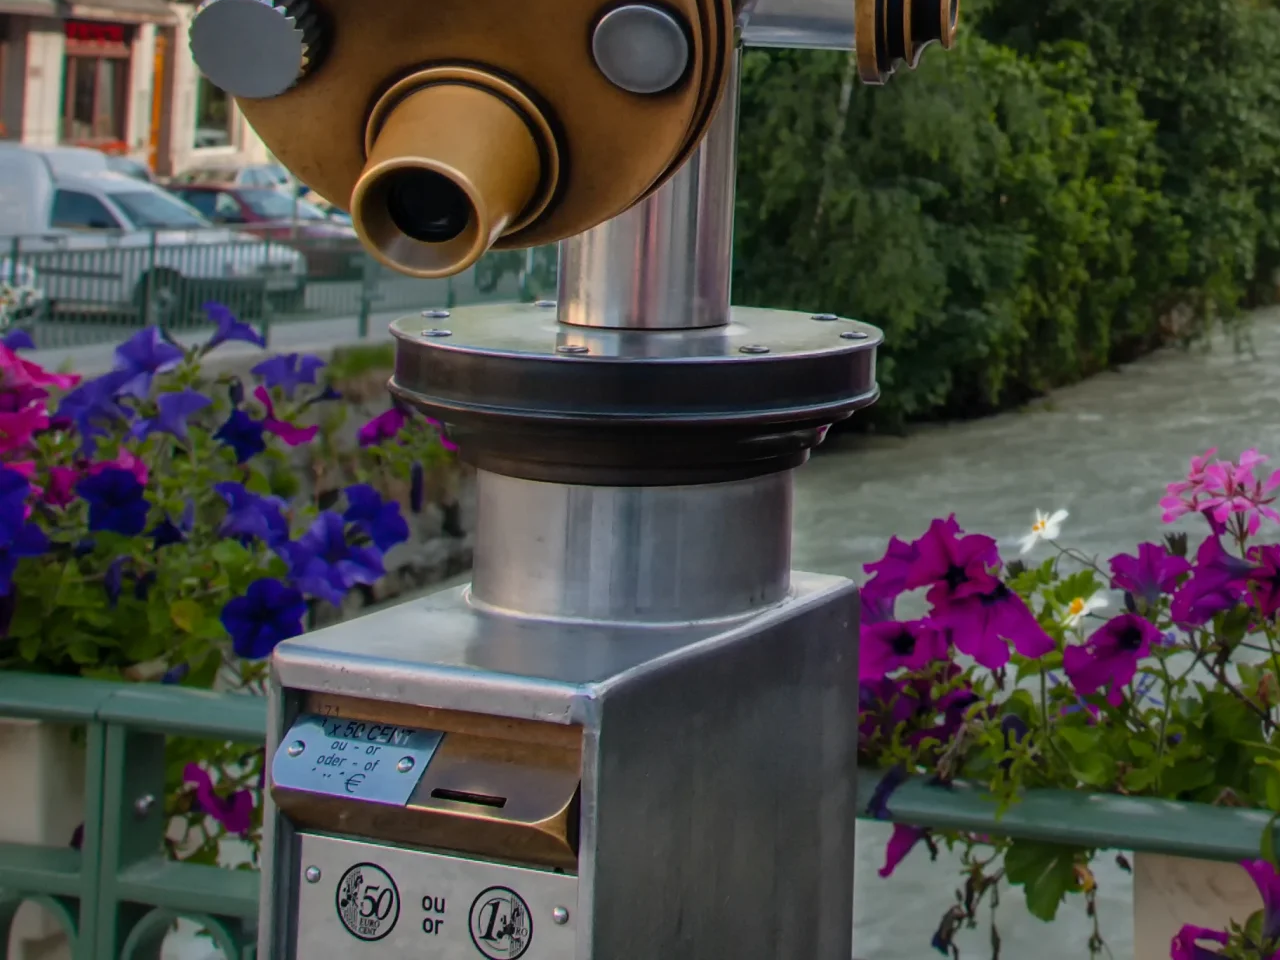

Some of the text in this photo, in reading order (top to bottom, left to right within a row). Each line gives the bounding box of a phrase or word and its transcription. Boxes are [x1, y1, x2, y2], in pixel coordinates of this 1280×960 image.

[328, 723, 341, 736] x
[343, 721, 365, 738] 50
[366, 725, 416, 745] CENT
[331, 741, 348, 751] ou
[365, 745, 381, 755] or
[316, 753, 348, 767] oder
[364, 760, 380, 771] of
[344, 773, 366, 793] €
[359, 885, 393, 920] 50
[421, 896, 445, 913] ou
[359, 918, 381, 928] EURO
[422, 917, 445, 935] or
[479, 901, 500, 942] 1
